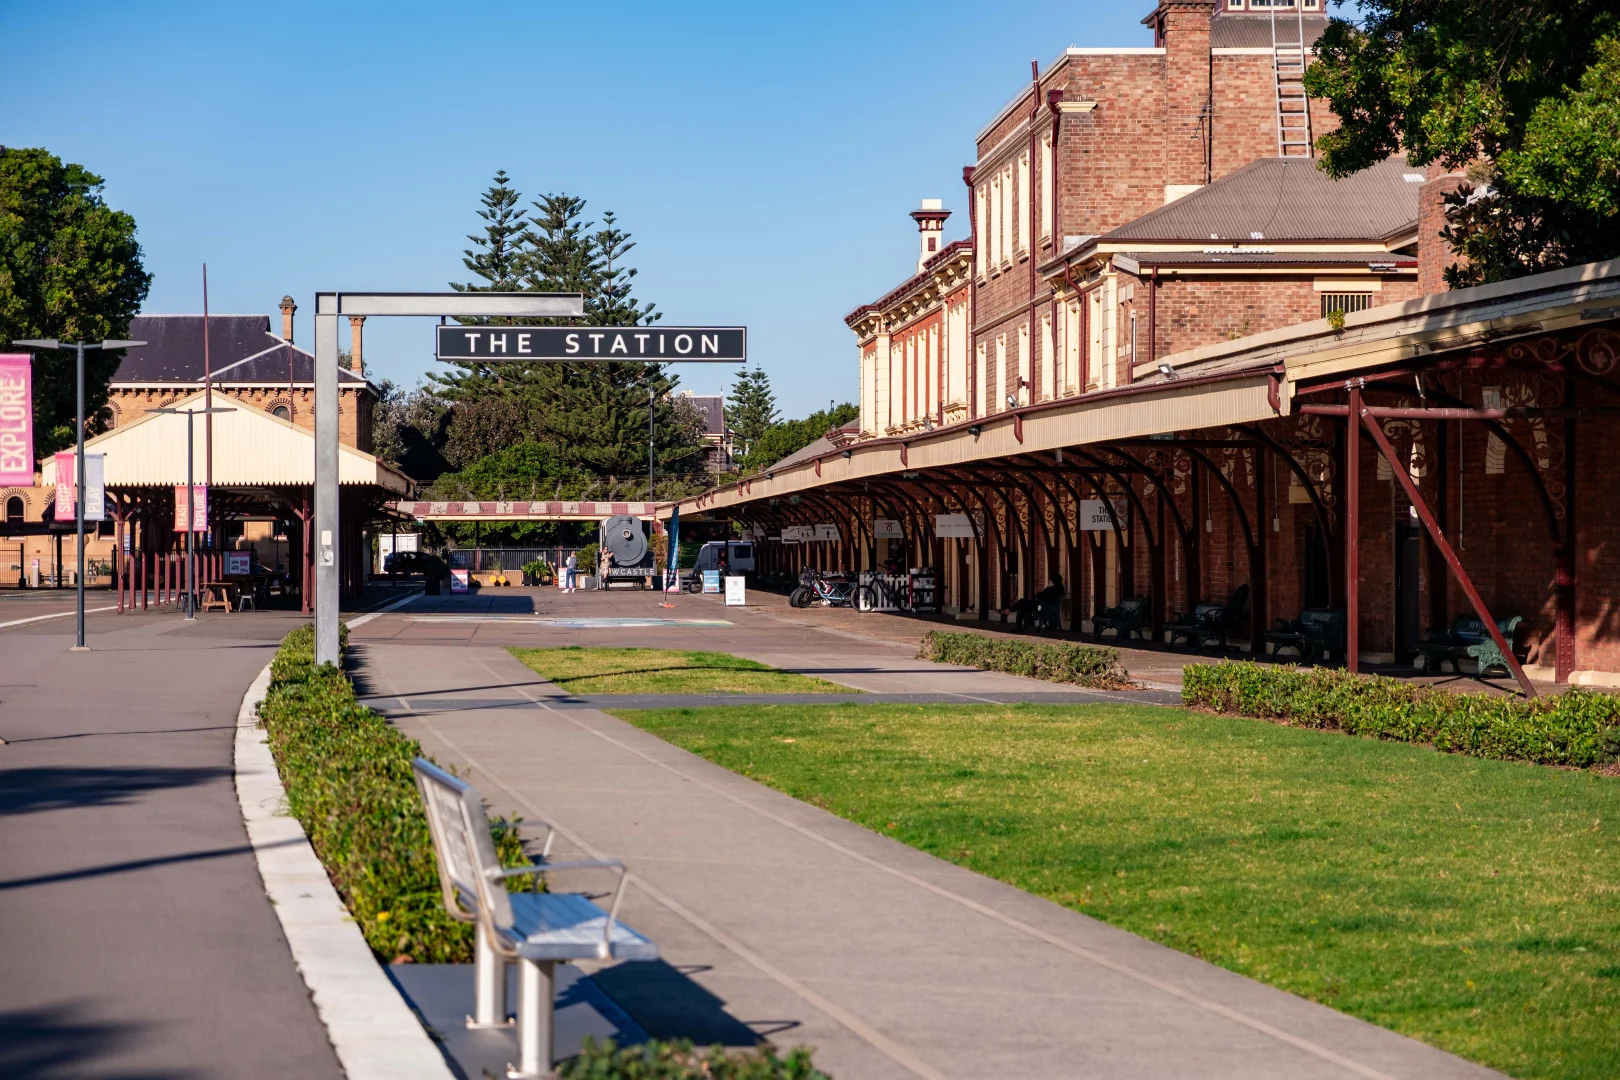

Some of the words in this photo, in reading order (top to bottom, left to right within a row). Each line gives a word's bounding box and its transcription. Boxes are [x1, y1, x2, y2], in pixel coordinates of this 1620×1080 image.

[465, 334, 532, 353] THE
[565, 334, 719, 353] STATION
[0, 378, 27, 472] EXPLORE
[58, 484, 71, 512] SHOP
[88, 487, 100, 512] PLAY
[178, 504, 186, 526] FEAST
[196, 493, 204, 527] EXPLORE
[1092, 515, 1113, 523] STATI
[609, 568, 655, 576] WCASTLE
